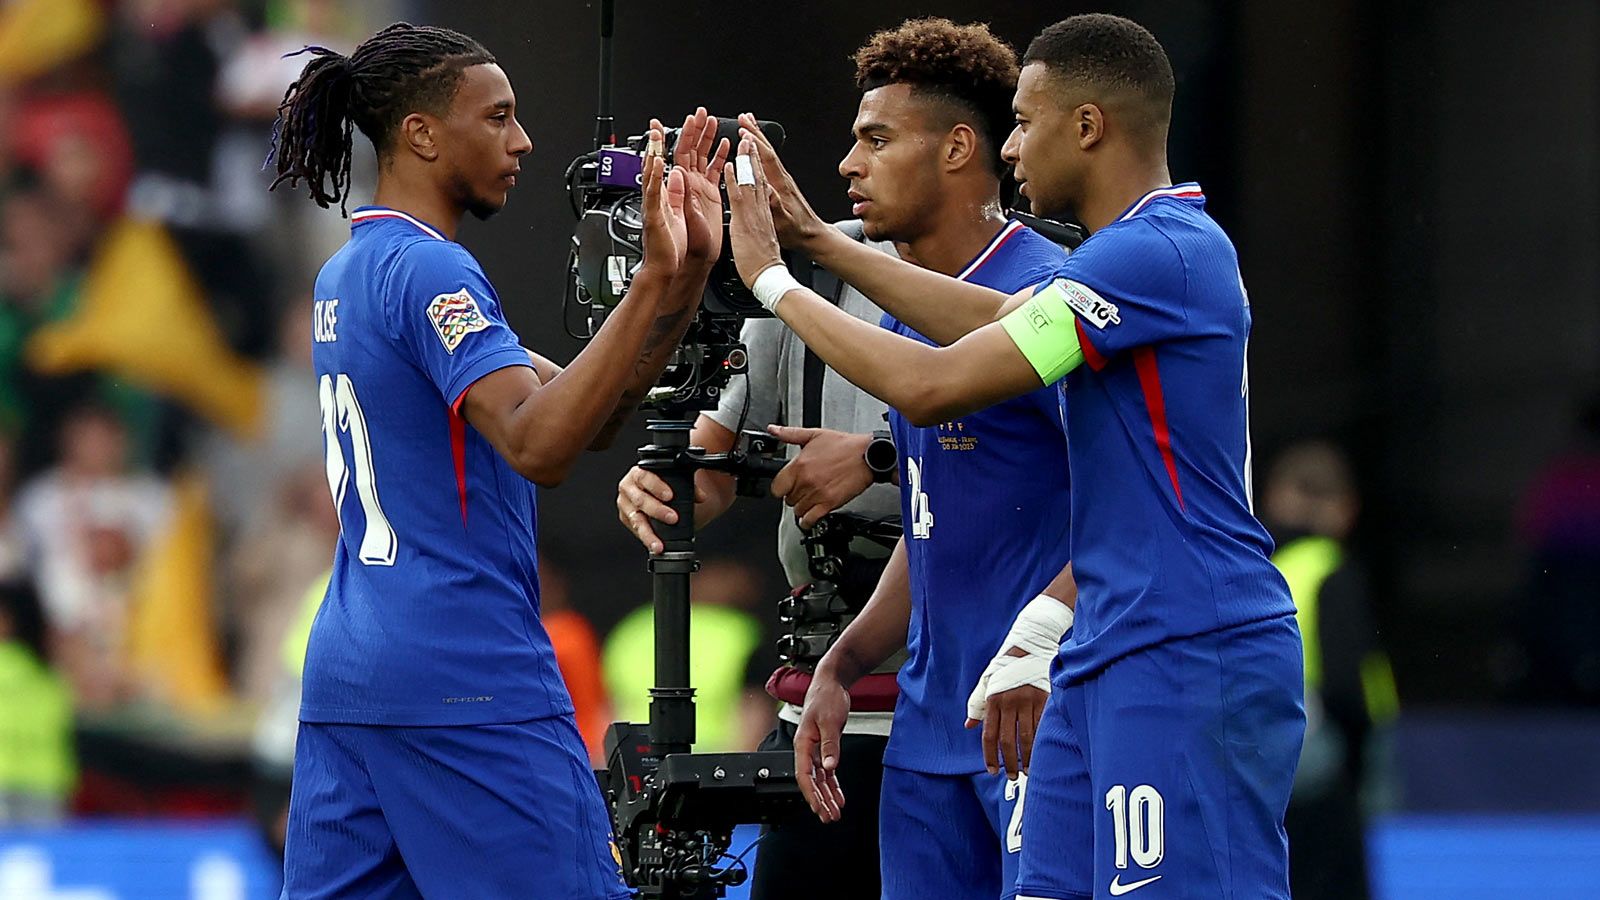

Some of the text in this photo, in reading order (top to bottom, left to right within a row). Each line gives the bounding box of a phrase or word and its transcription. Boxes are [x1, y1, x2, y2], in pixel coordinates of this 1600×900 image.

[601, 156, 613, 176] 021
[314, 299, 339, 342] OLISE
[319, 374, 399, 566] 11
[907, 456, 934, 540] 24
[1005, 771, 1029, 853] 2
[1105, 784, 1164, 869] 10
